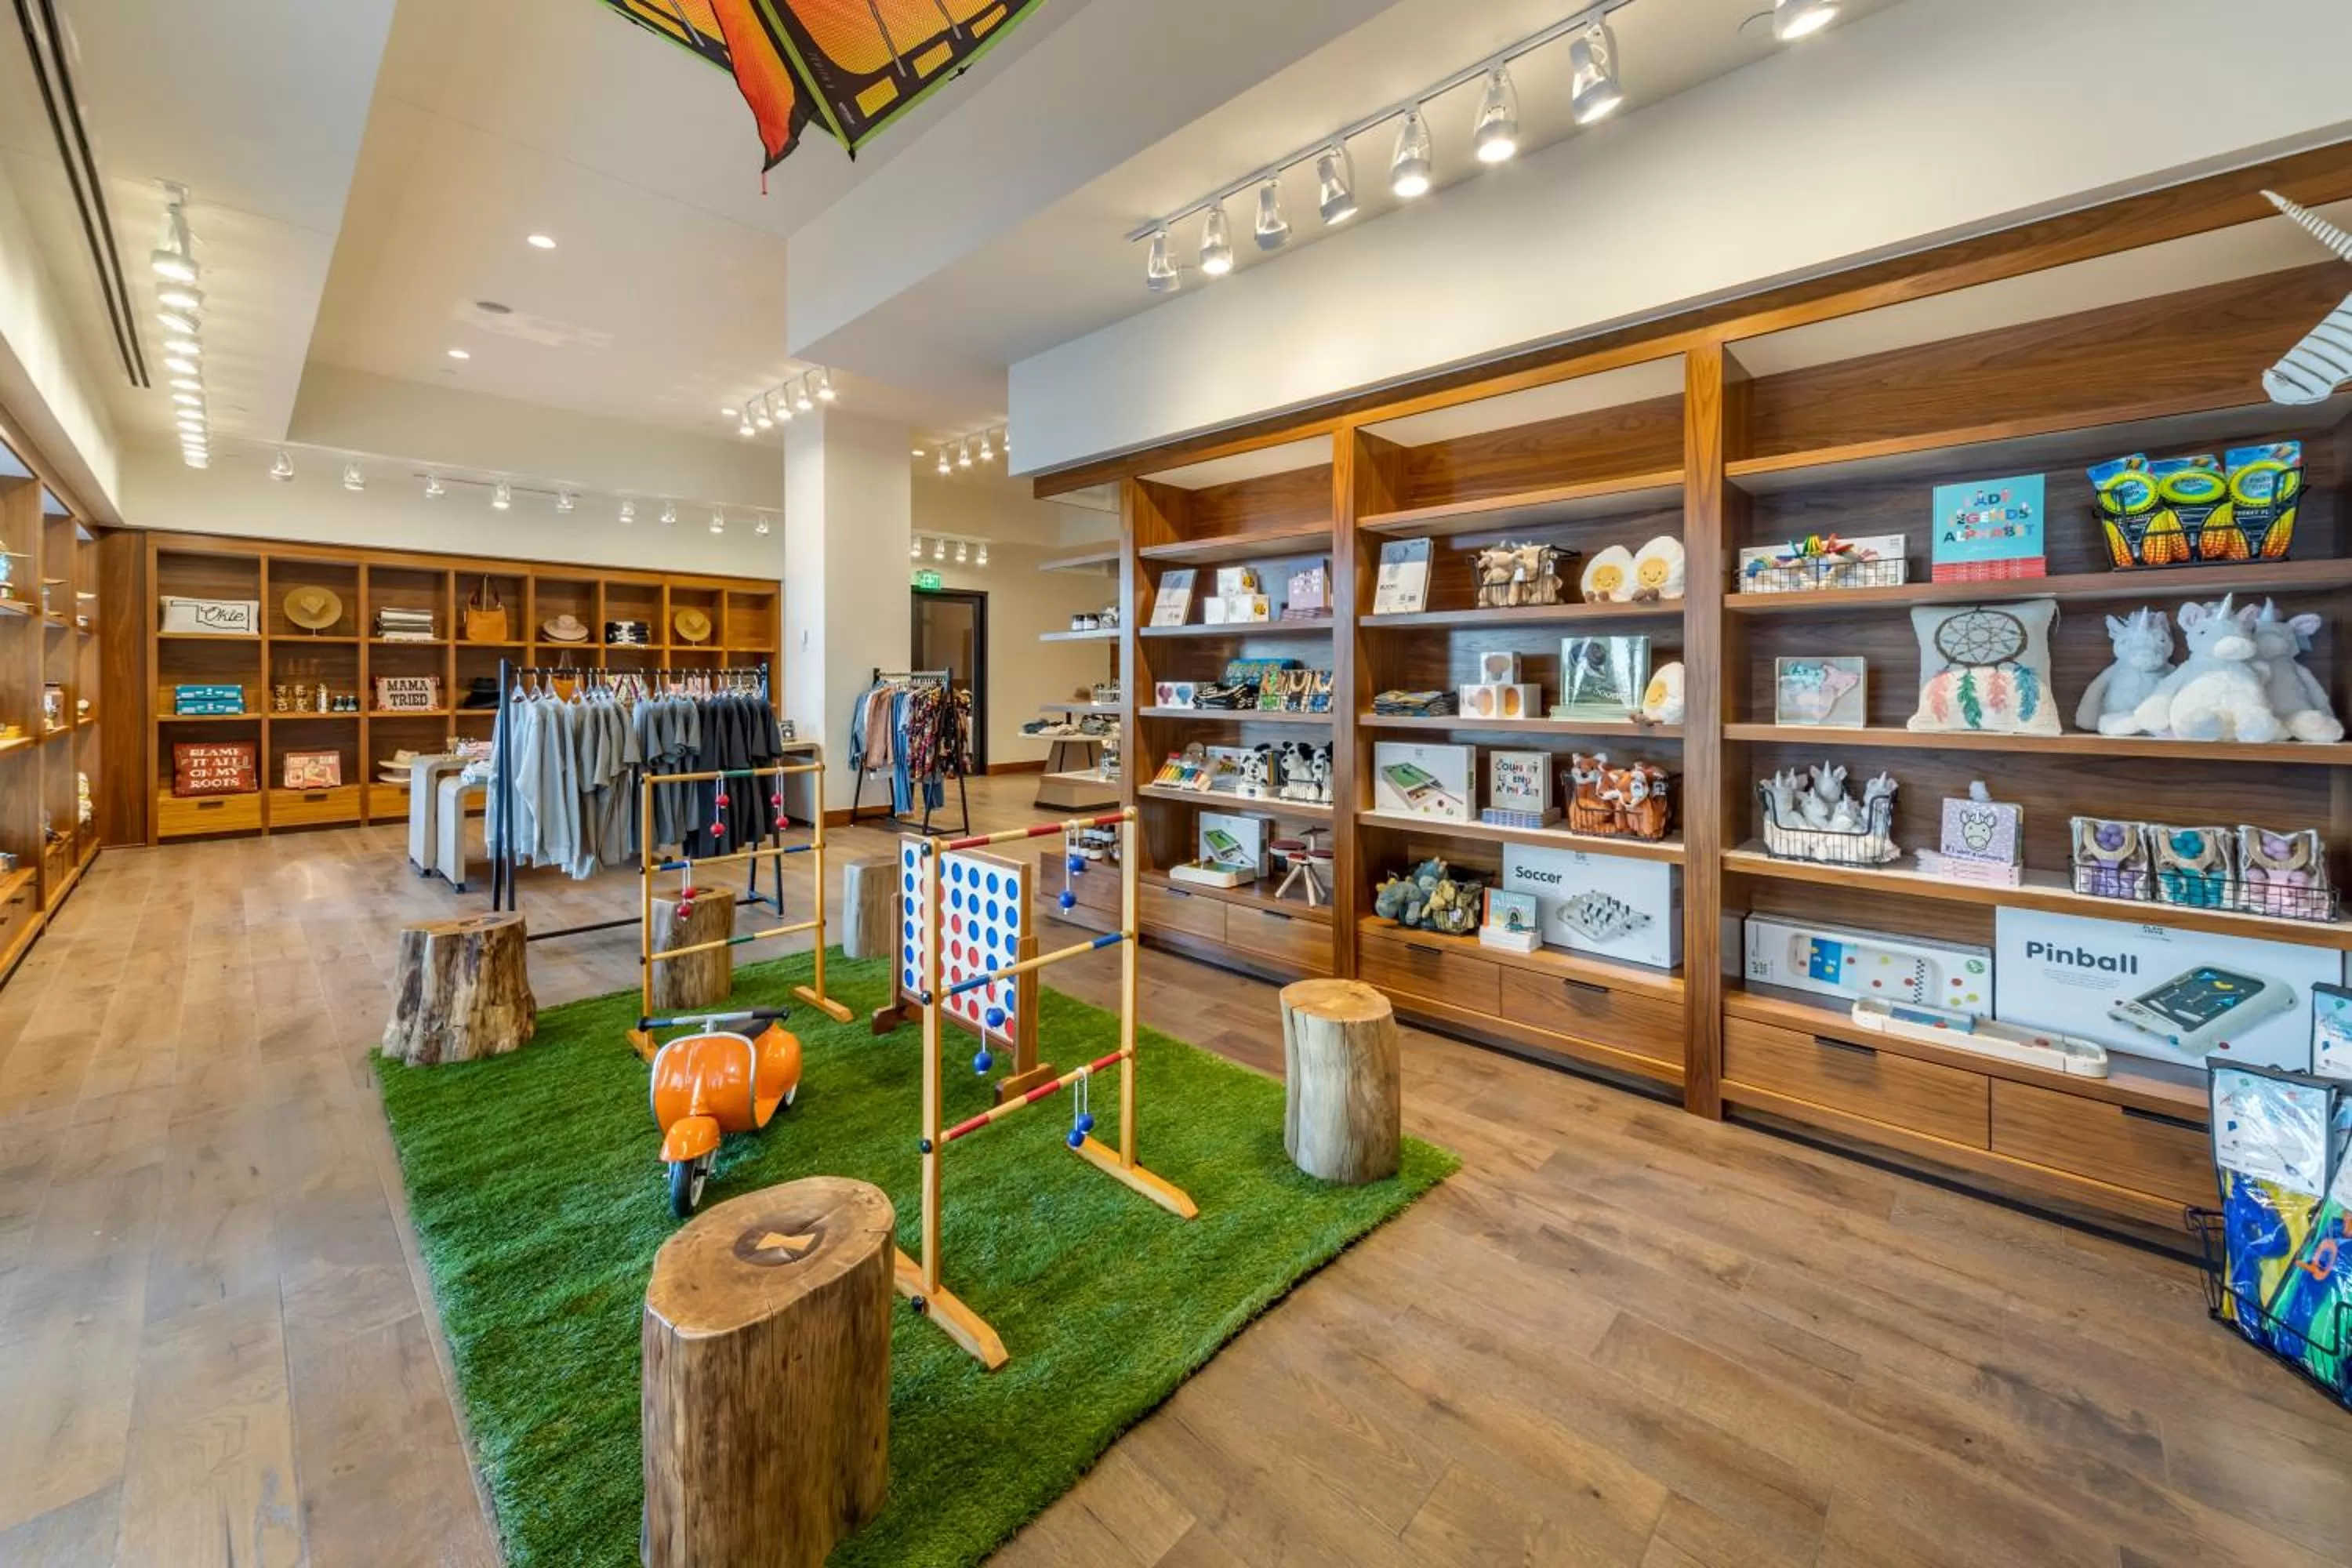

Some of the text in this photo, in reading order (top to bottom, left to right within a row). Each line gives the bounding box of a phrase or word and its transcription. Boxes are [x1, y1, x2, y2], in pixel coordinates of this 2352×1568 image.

[201, 606, 245, 622] Okie
[387, 680, 428, 691] MAMA
[390, 693, 428, 706] TRIED
[189, 747, 240, 757] BLAME
[193, 757, 209, 768] IT
[216, 768, 240, 776] MY
[191, 777, 240, 789] ROOTS
[1515, 866, 1562, 884] Soccer
[2027, 941, 2137, 975] Pinball
